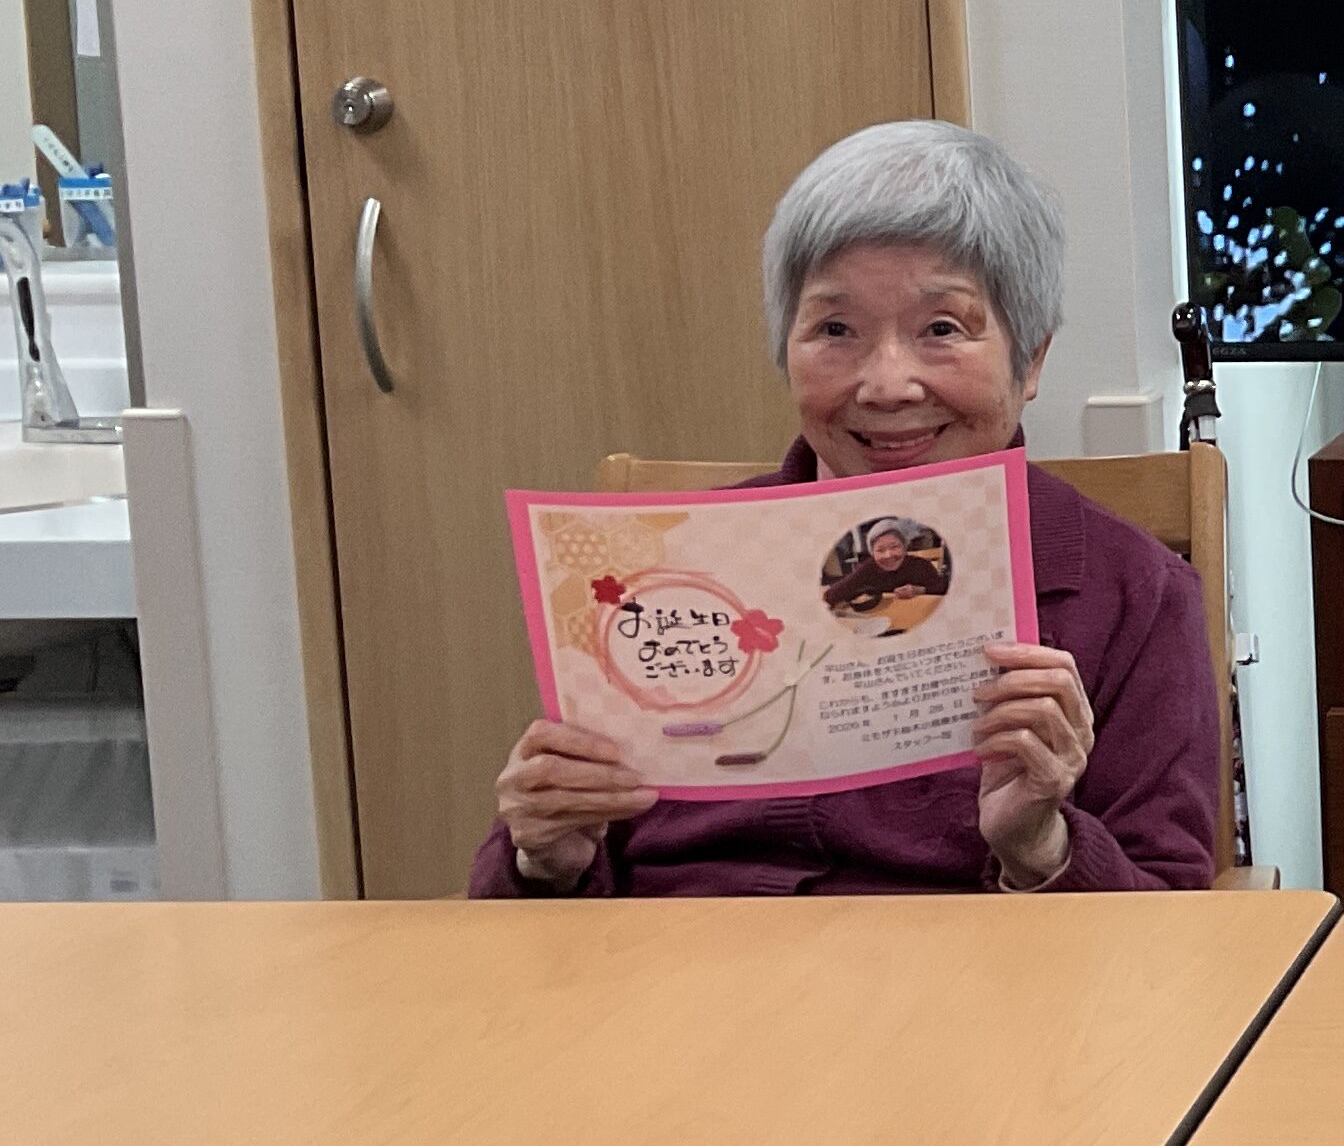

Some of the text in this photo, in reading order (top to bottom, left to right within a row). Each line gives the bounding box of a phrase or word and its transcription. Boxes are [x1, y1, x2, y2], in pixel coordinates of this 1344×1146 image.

[617, 597, 730, 639] お誕生日
[638, 636, 729, 662] おめでとう
[645, 656, 740, 679] ございます
